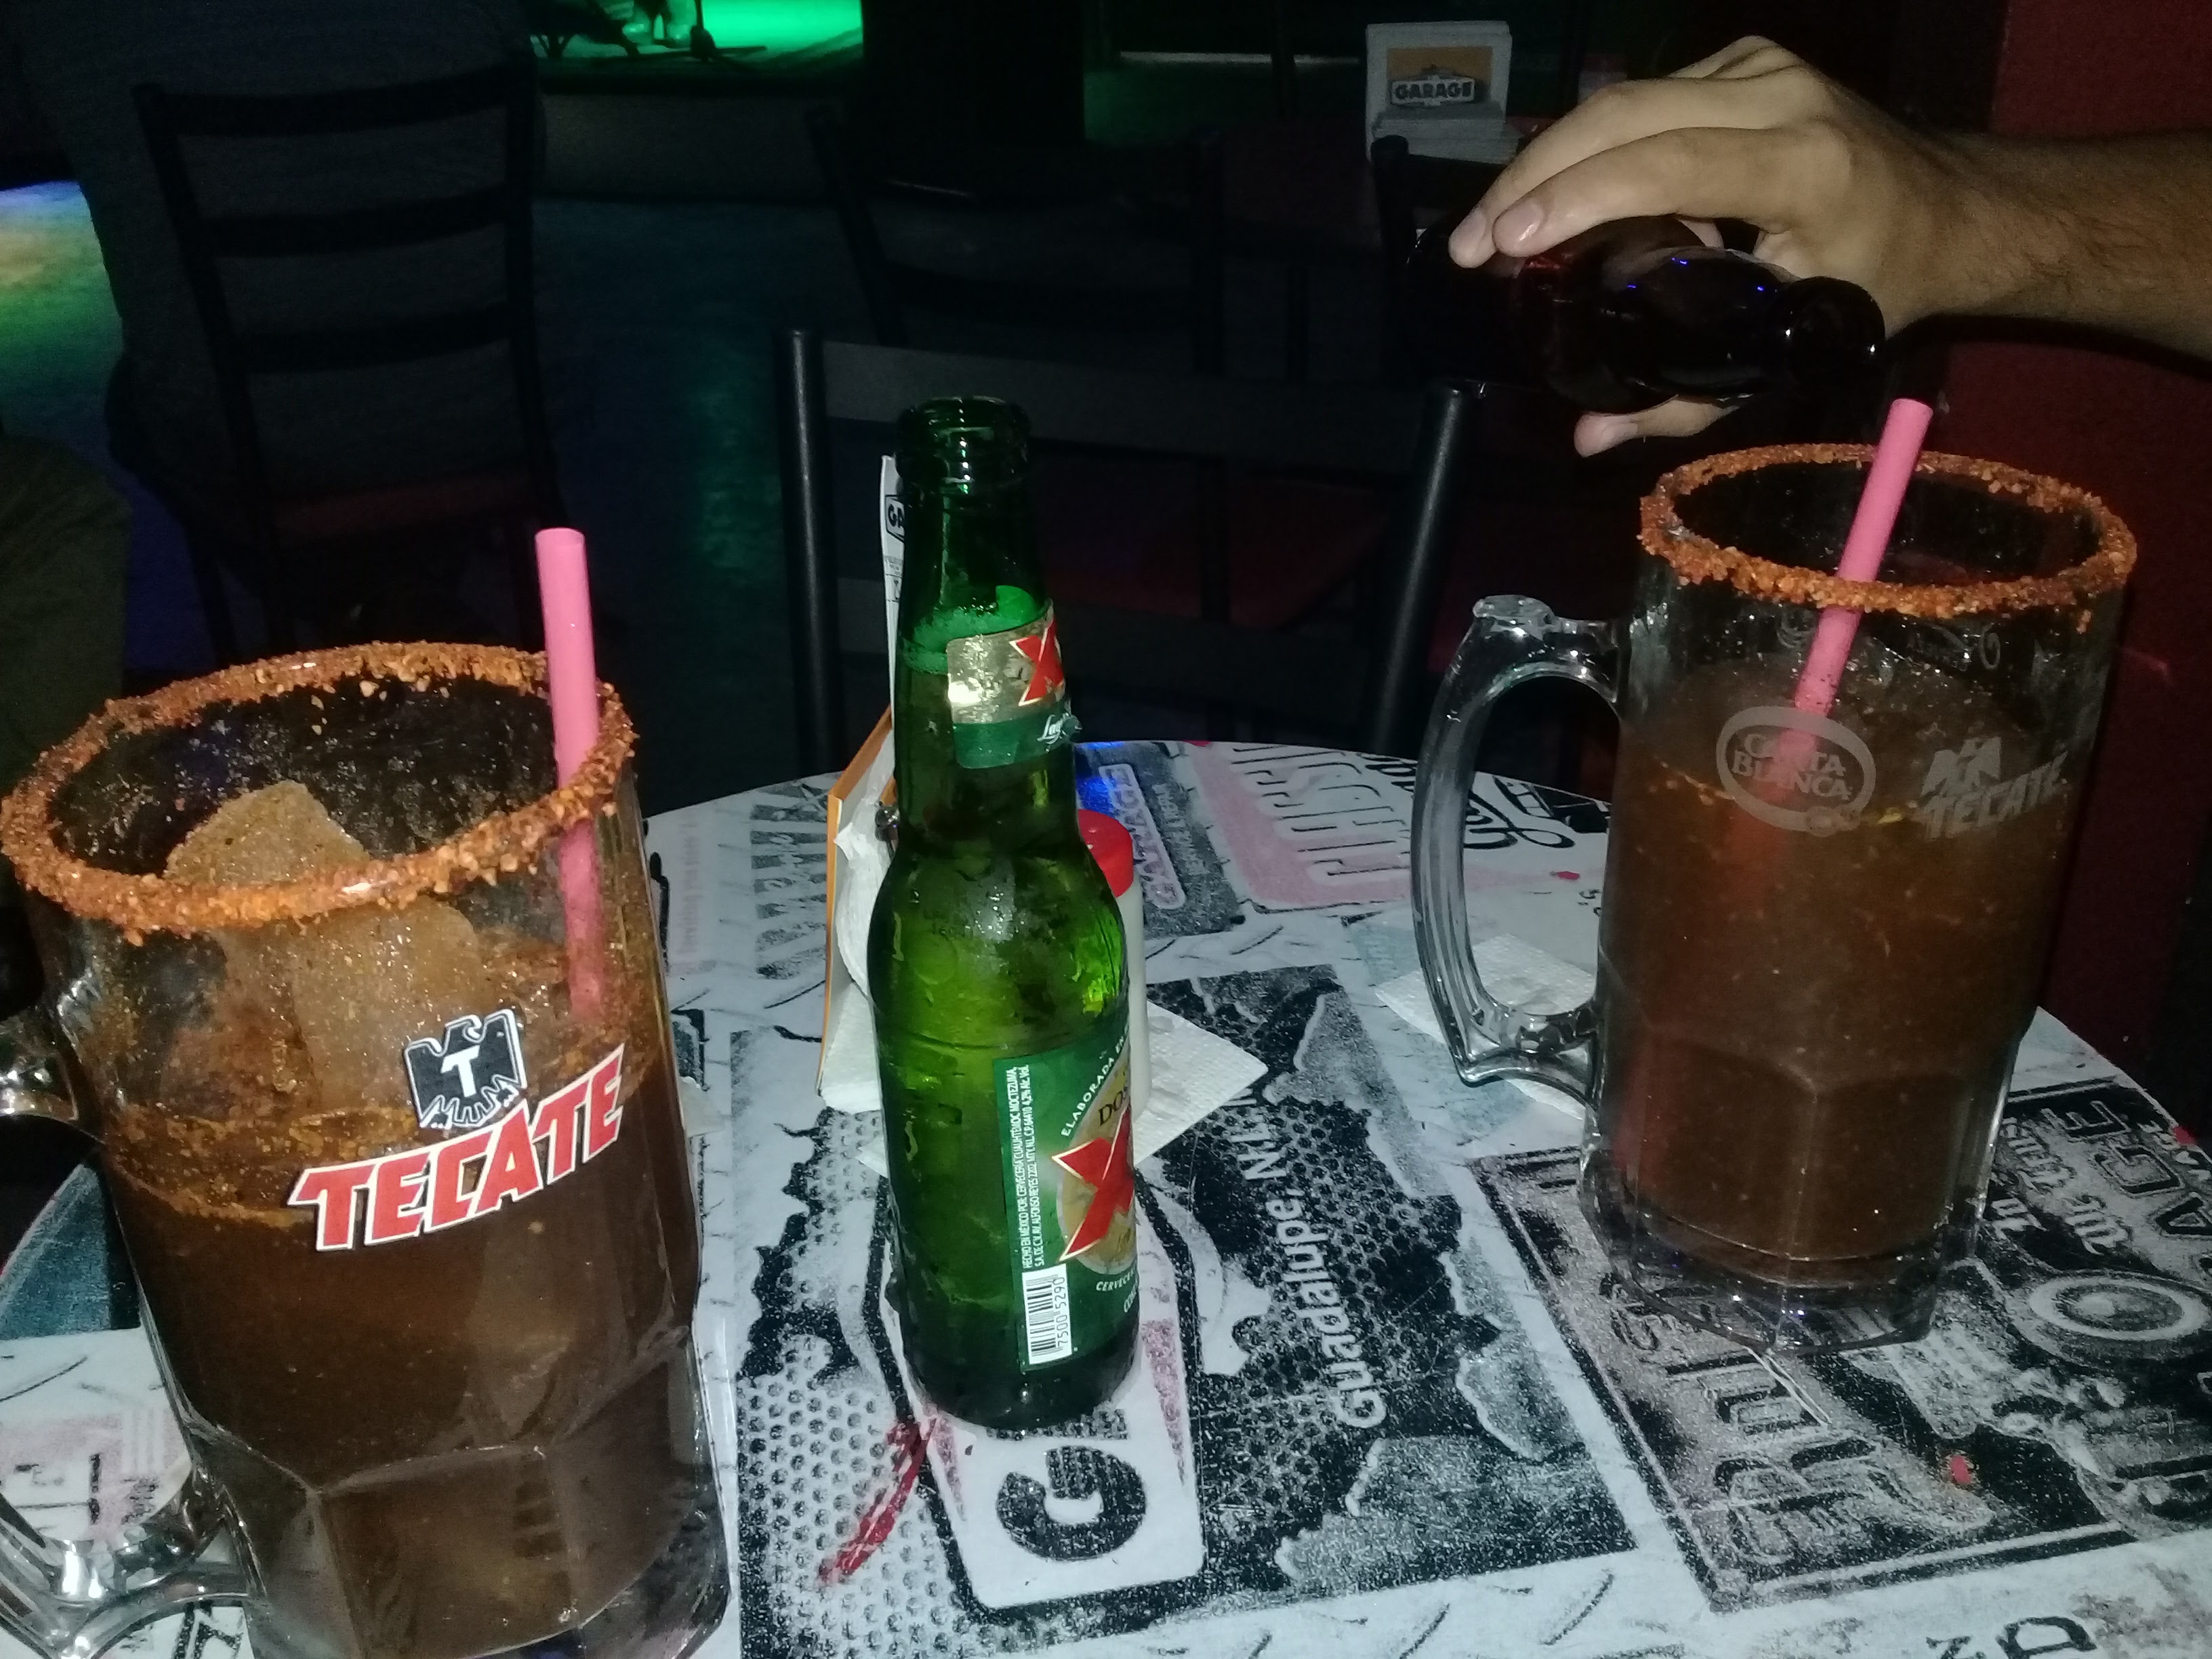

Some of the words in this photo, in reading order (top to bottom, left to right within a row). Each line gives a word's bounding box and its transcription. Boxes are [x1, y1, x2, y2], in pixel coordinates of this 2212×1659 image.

[1744, 733, 1847, 777] CTA
[1061, 1057, 1115, 1137] ELABORADA
[287, 1042, 625, 1251] TECATE
[1022, 1246, 1032, 1269] HECHO
